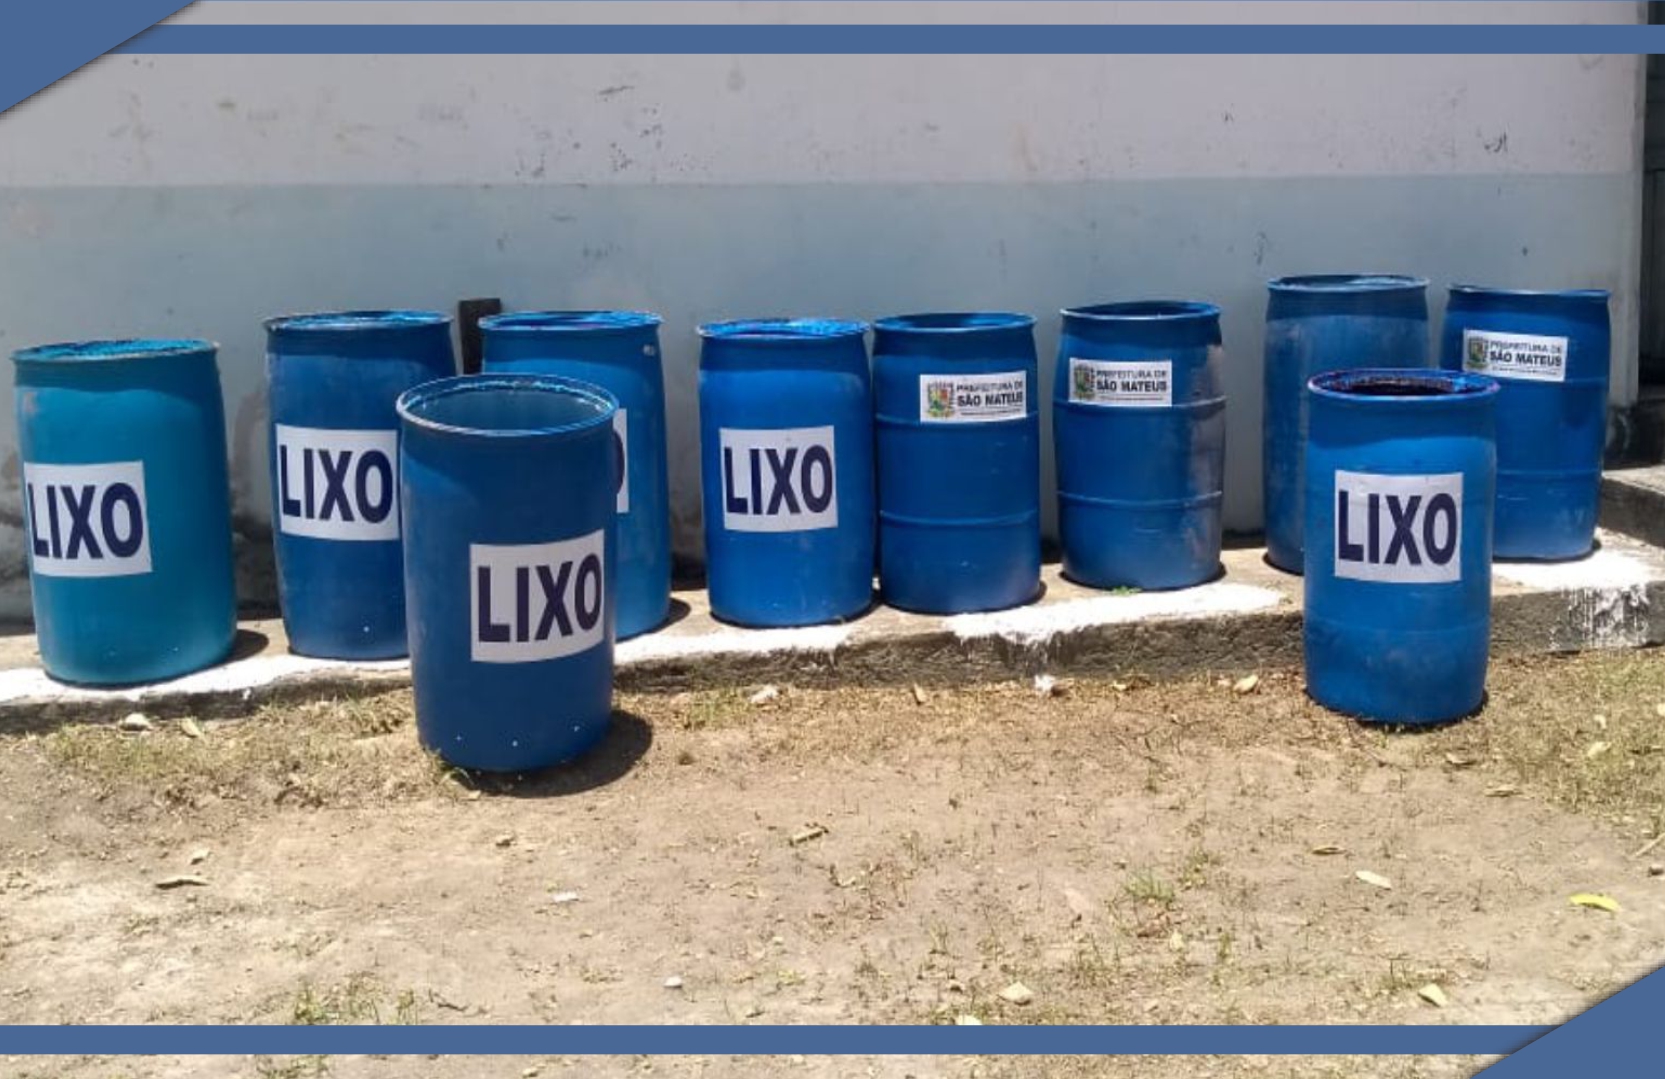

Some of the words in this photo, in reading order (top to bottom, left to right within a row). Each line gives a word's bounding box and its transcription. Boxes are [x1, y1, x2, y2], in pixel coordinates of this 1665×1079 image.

[1096, 379, 1117, 391] SÃO
[1121, 381, 1167, 392] MATEUS
[1490, 349, 1512, 362] SÃO
[1515, 353, 1562, 366] MATEUS
[957, 392, 980, 407] SÃO
[985, 391, 1023, 405] MATEUS
[279, 444, 393, 523] LIXO
[723, 444, 833, 515] LIXO
[27, 482, 143, 560] LIXO
[1338, 490, 1457, 565] LIXO
[477, 553, 602, 642] LIXO
